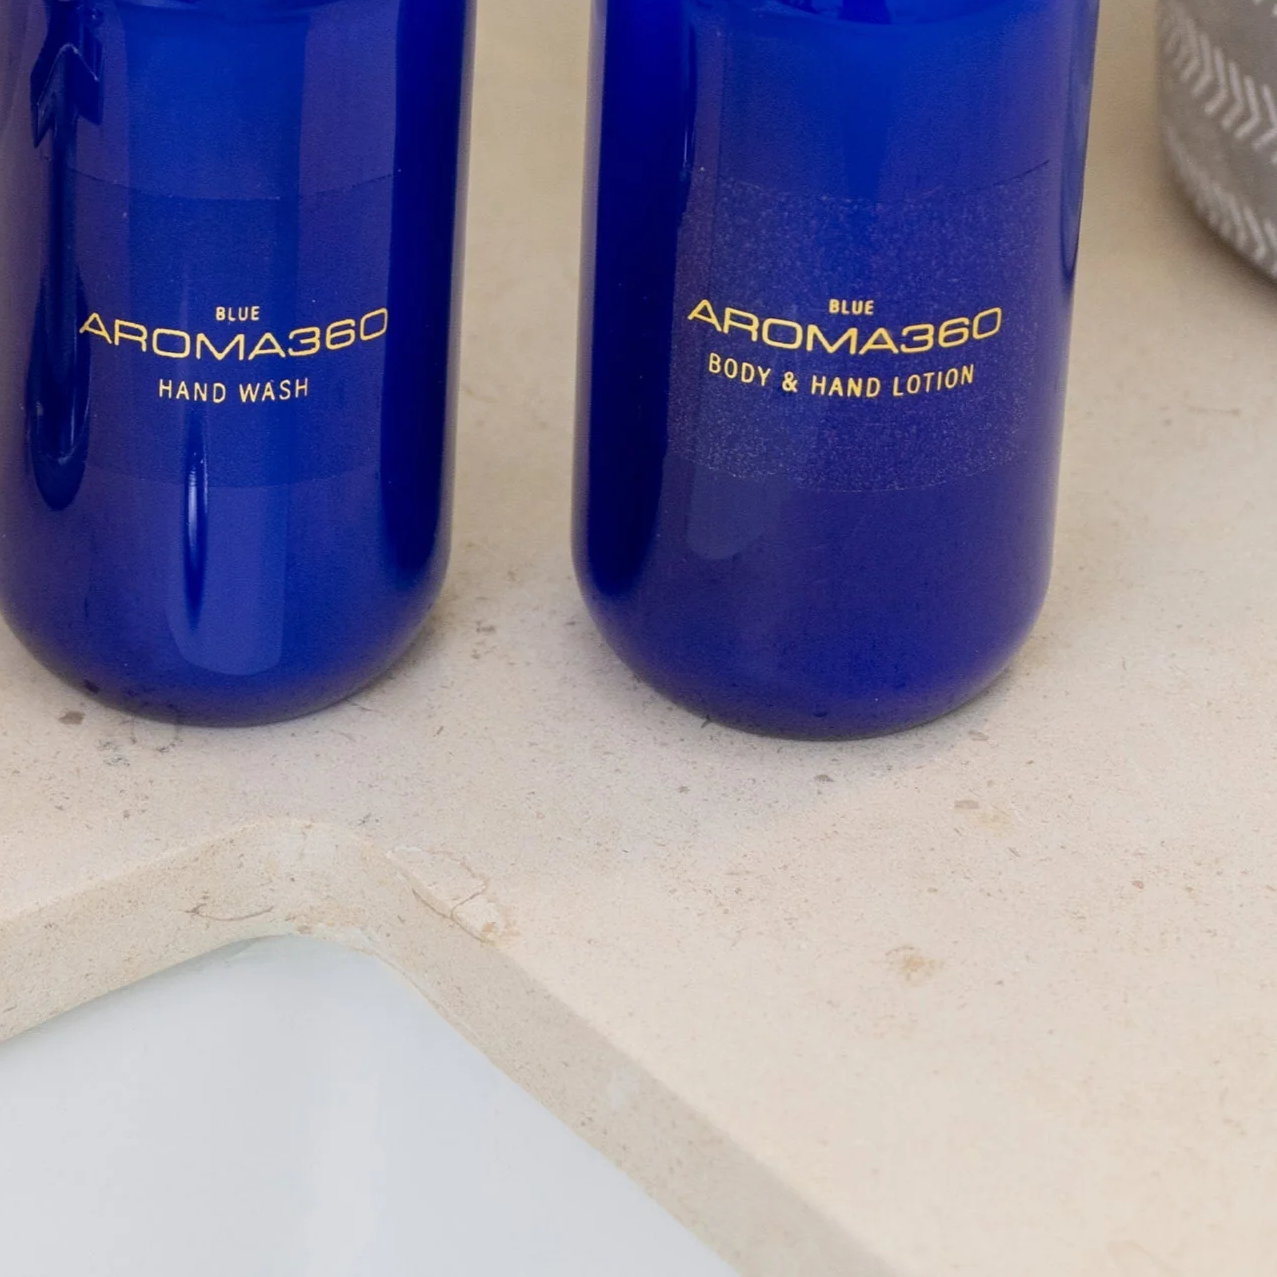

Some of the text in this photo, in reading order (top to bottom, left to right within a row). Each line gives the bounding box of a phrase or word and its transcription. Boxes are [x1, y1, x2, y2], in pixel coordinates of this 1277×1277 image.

[215, 305, 260, 322] BLUE
[828, 298, 875, 316] BLUE
[79, 305, 388, 361] AROMA360
[687, 298, 1003, 356] AROMA360
[158, 377, 308, 404] HAND WASH
[708, 352, 974, 398] BODY & HAND LOTION
